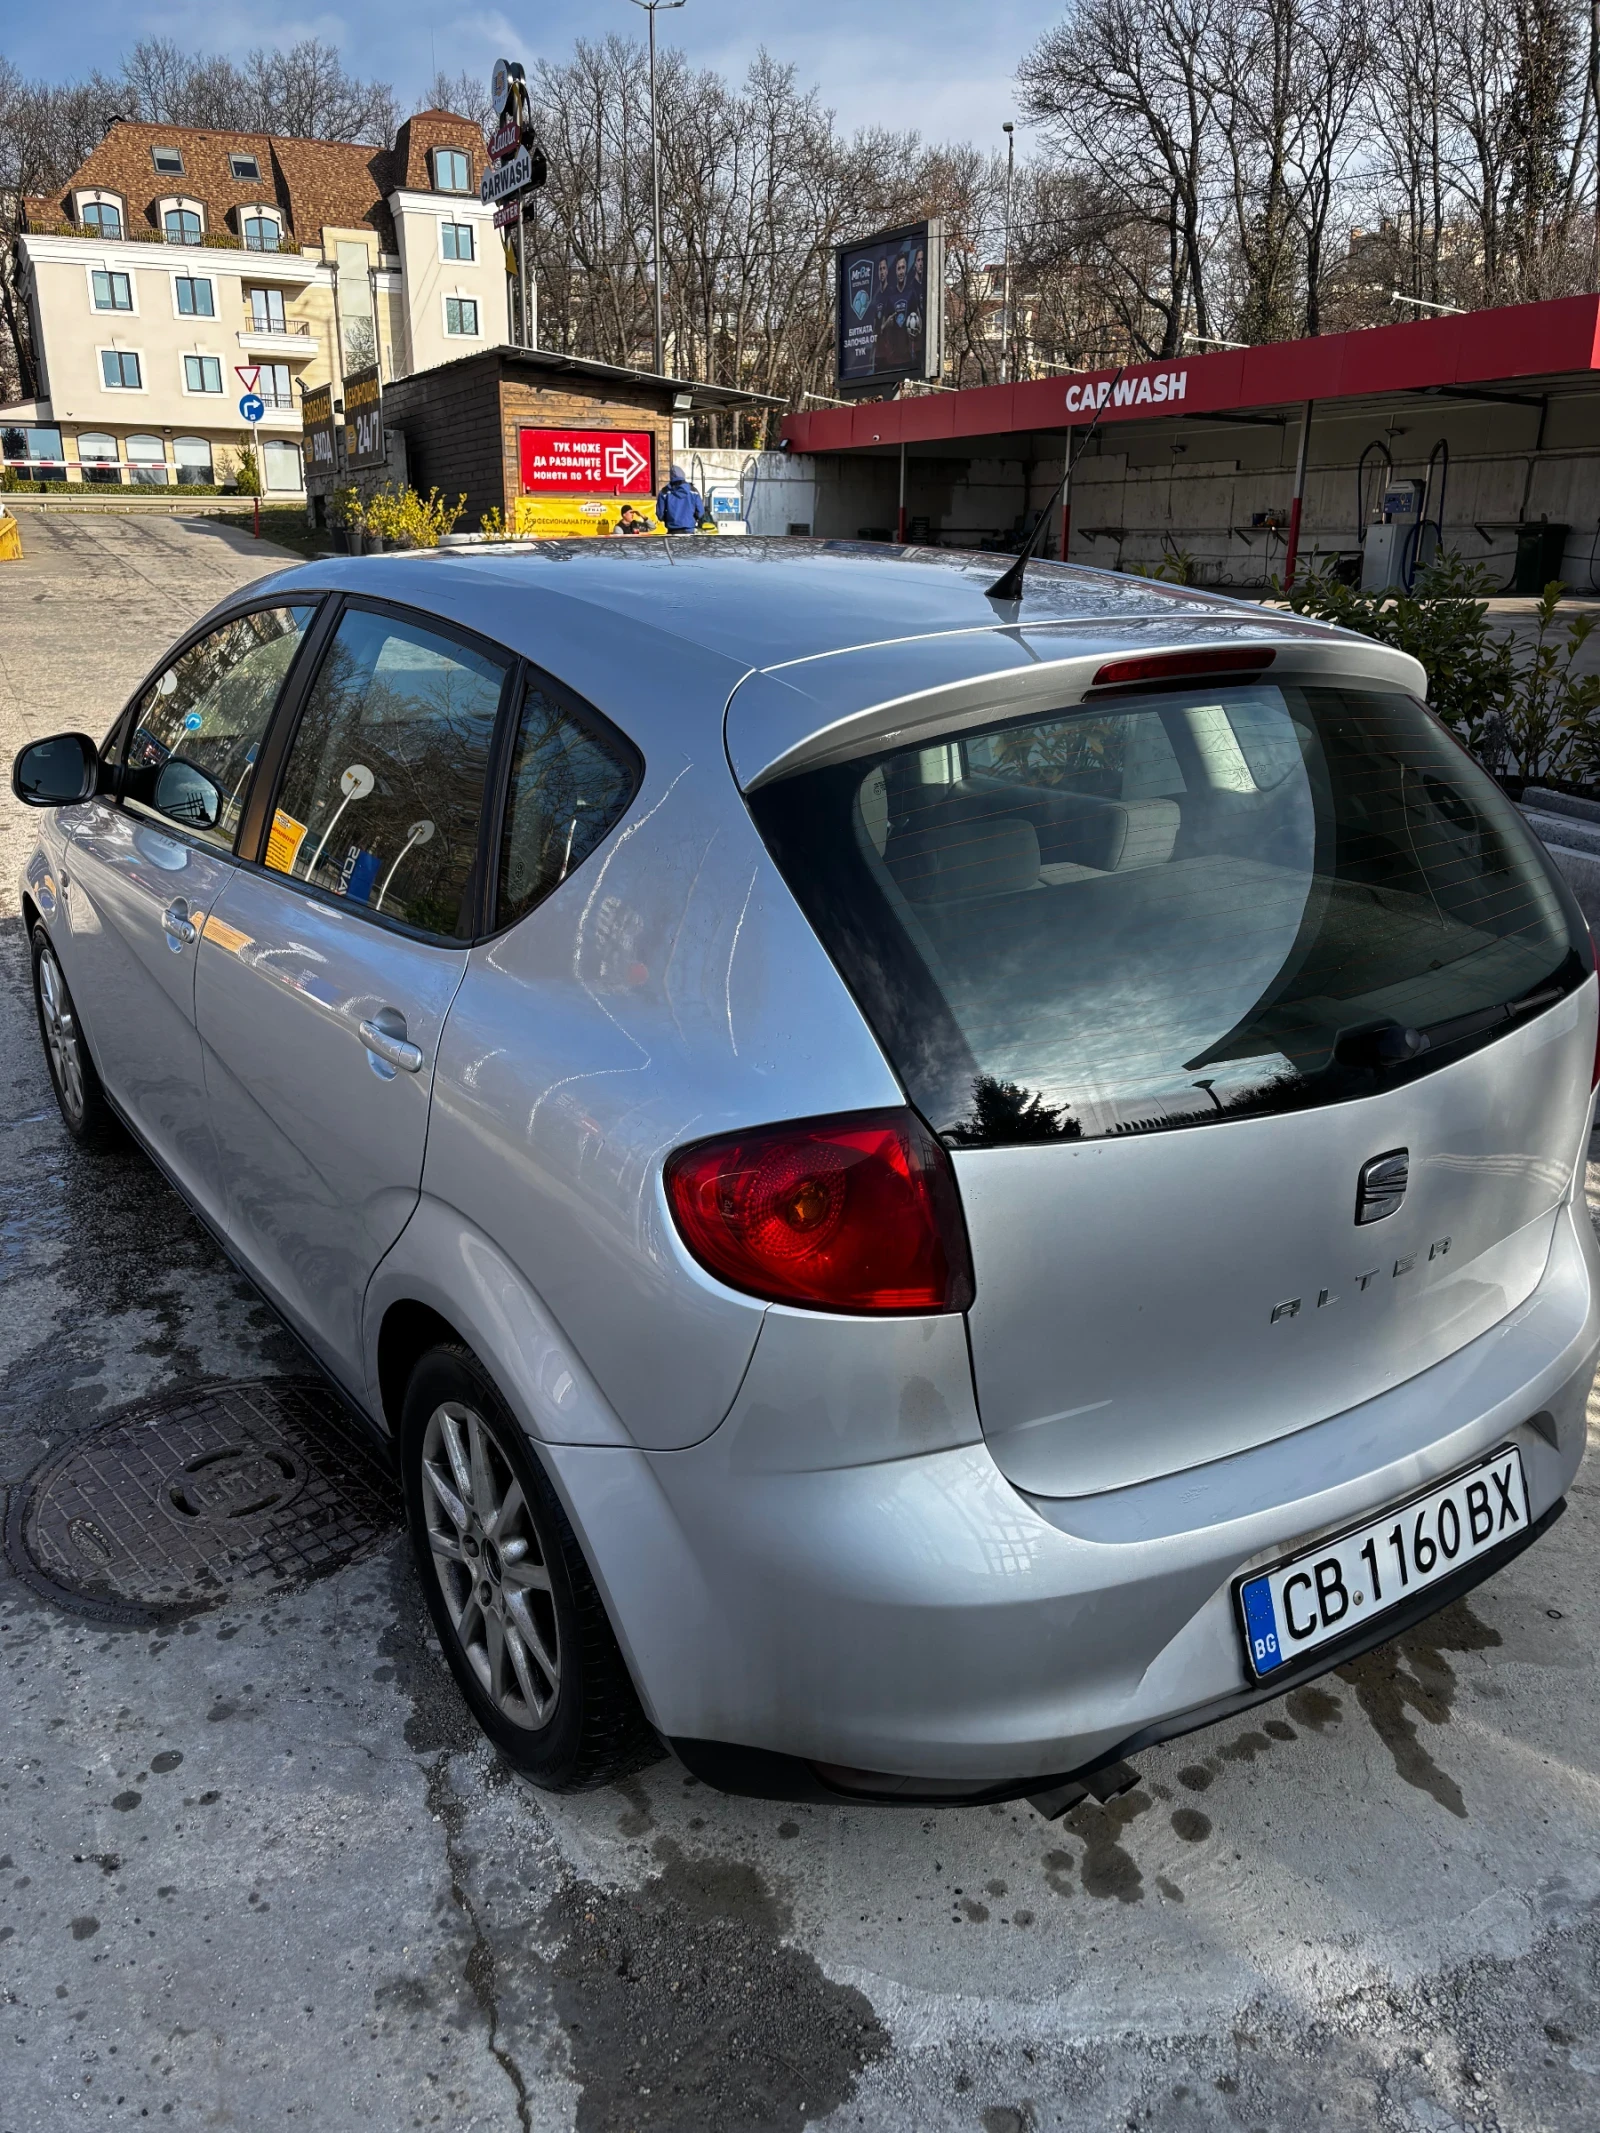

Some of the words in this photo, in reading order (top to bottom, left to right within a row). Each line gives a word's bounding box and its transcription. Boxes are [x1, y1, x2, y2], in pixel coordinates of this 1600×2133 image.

[491, 126, 516, 154] Laura
[481, 156, 530, 202] CARWASH
[494, 205, 519, 227] CENTER
[844, 336, 870, 349] ЗАПОЧВА
[870, 334, 878, 343] ОТ
[849, 324, 873, 337] БИТКАТА
[1065, 371, 1187, 412] CARWASH
[356, 410, 379, 454] 24/7
[313, 430, 333, 465] ВХОД
[553, 442, 570, 452] ТУК
[573, 442, 601, 453] МОЖЕ
[533, 456, 547, 468] ДА
[549, 456, 601, 468] РАЗВАЛИТЕ
[533, 471, 567, 480] монети
[570, 471, 582, 480] по
[585, 468, 601, 481] 1€
[1254, 1633, 1277, 1660] BG
